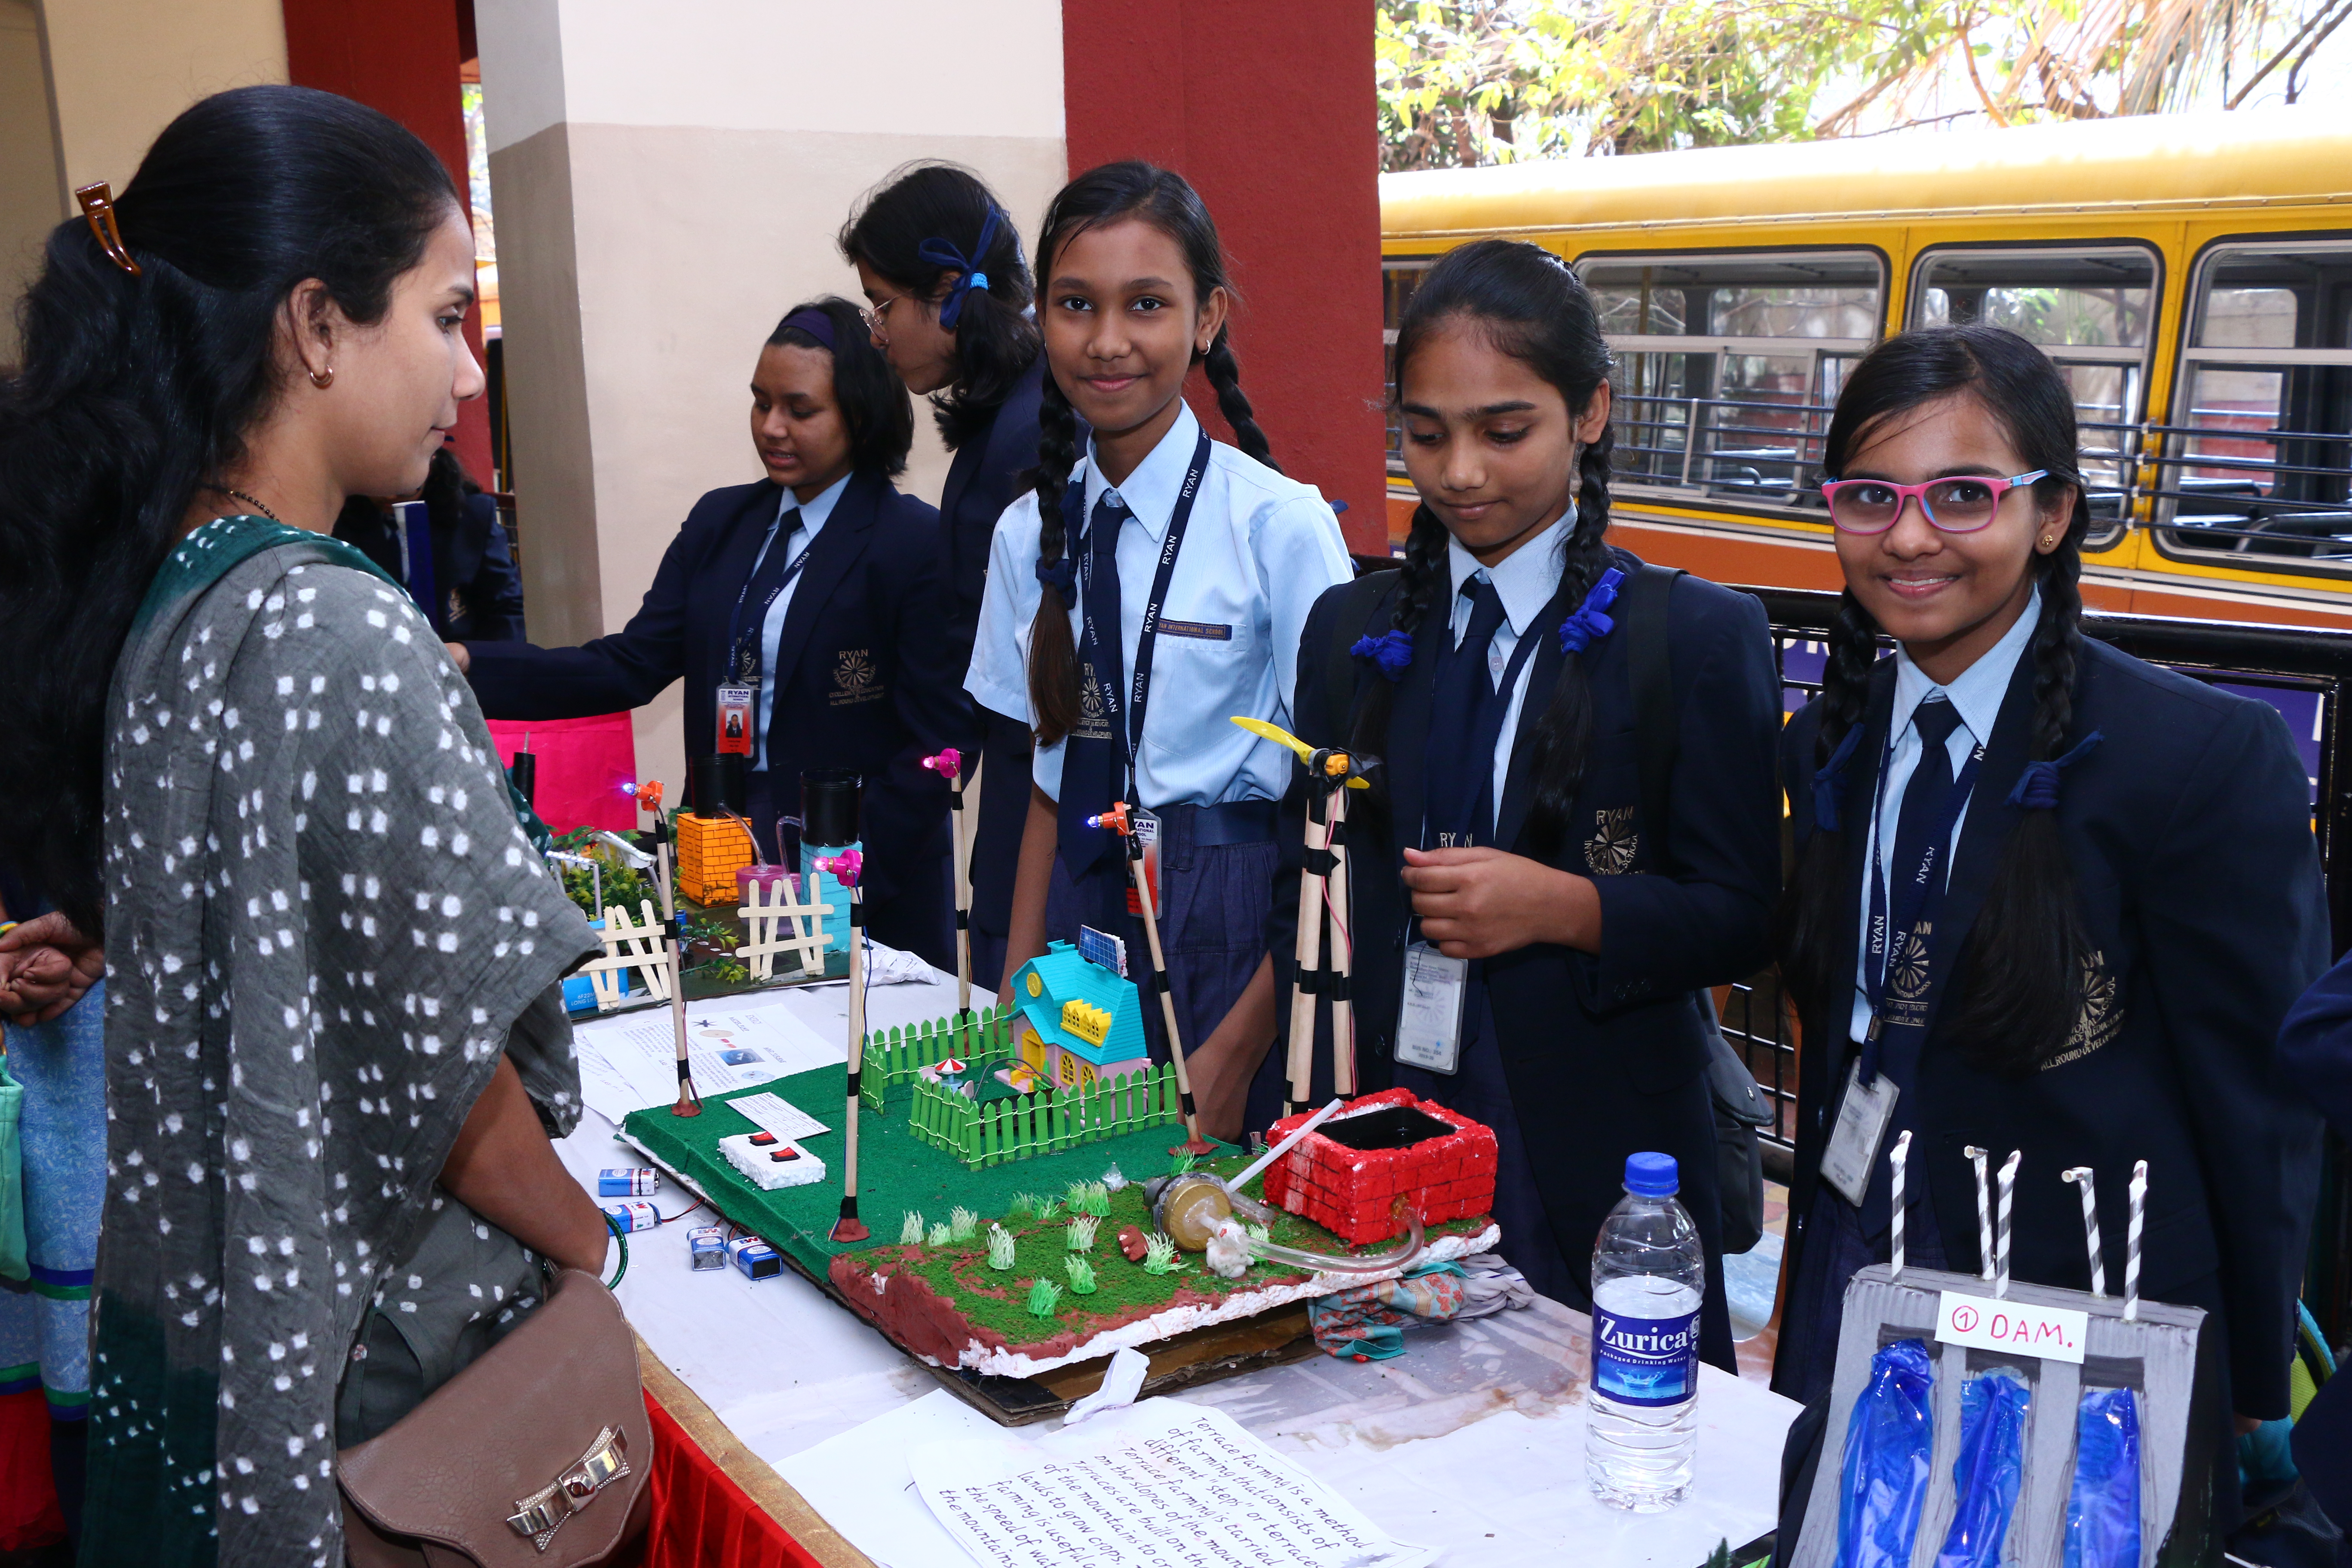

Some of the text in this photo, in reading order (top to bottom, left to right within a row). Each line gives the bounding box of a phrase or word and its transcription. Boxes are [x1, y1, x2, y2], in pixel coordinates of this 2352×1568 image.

[1182, 469, 1199, 498] RYAN
[794, 551, 810, 568] RYAN
[1162, 535, 1177, 565] RYAN
[765, 587, 779, 604] RYAN
[1087, 616, 1098, 646] RYAN
[1144, 603, 1158, 633] RYAN
[1168, 625, 1204, 634] INTERNATIONAL
[839, 649, 868, 660] RYAN
[1084, 663, 1096, 676] RY
[1104, 683, 1118, 713] RYAN
[1134, 673, 1144, 702] RYAN
[1596, 806, 1634, 825] RYAN
[1439, 832, 1472, 848] RYN
[1622, 833, 1638, 869] SCHOOL
[1916, 846, 1935, 884] RYAN
[1871, 916, 1884, 954] RYAN
[1913, 921, 1932, 934] AN
[1889, 931, 1907, 967] RYAN
[1600, 1315, 1688, 1351] Zurica
[1991, 1314, 2073, 1348] DAM.
[1600, 1349, 1630, 1364] Packaged
[1668, 1356, 1686, 1364] Water
[1168, 1428, 1193, 1439] of
[1179, 1438, 1236, 1478] farming
[1094, 1455, 1113, 1466] on
[1110, 1465, 1134, 1480] the
[1129, 1482, 1170, 1510] slopes
[1165, 1511, 1193, 1522] of
[1181, 1520, 1207, 1538] the
[1144, 1439, 1209, 1480] different
[1246, 1512, 1267, 1522] or
[1191, 1417, 1375, 1548] Terrace farming is a method
[987, 1480, 1095, 1563] farming is useful
[1017, 1470, 1127, 1565] lands to grow crops.
[1044, 1464, 1173, 1568] of the mountains to cr
[1118, 1447, 1285, 1566] Terrace farming is carried
[939, 1489, 1019, 1568] the mountains
[965, 1486, 1063, 1568] the speed of wat
[1116, 1496, 1142, 1515] are
[1137, 1516, 1175, 1537] built
[1166, 1537, 1187, 1553] on
[1184, 1553, 1210, 1568] th
[1312, 1537, 1340, 1550] of
